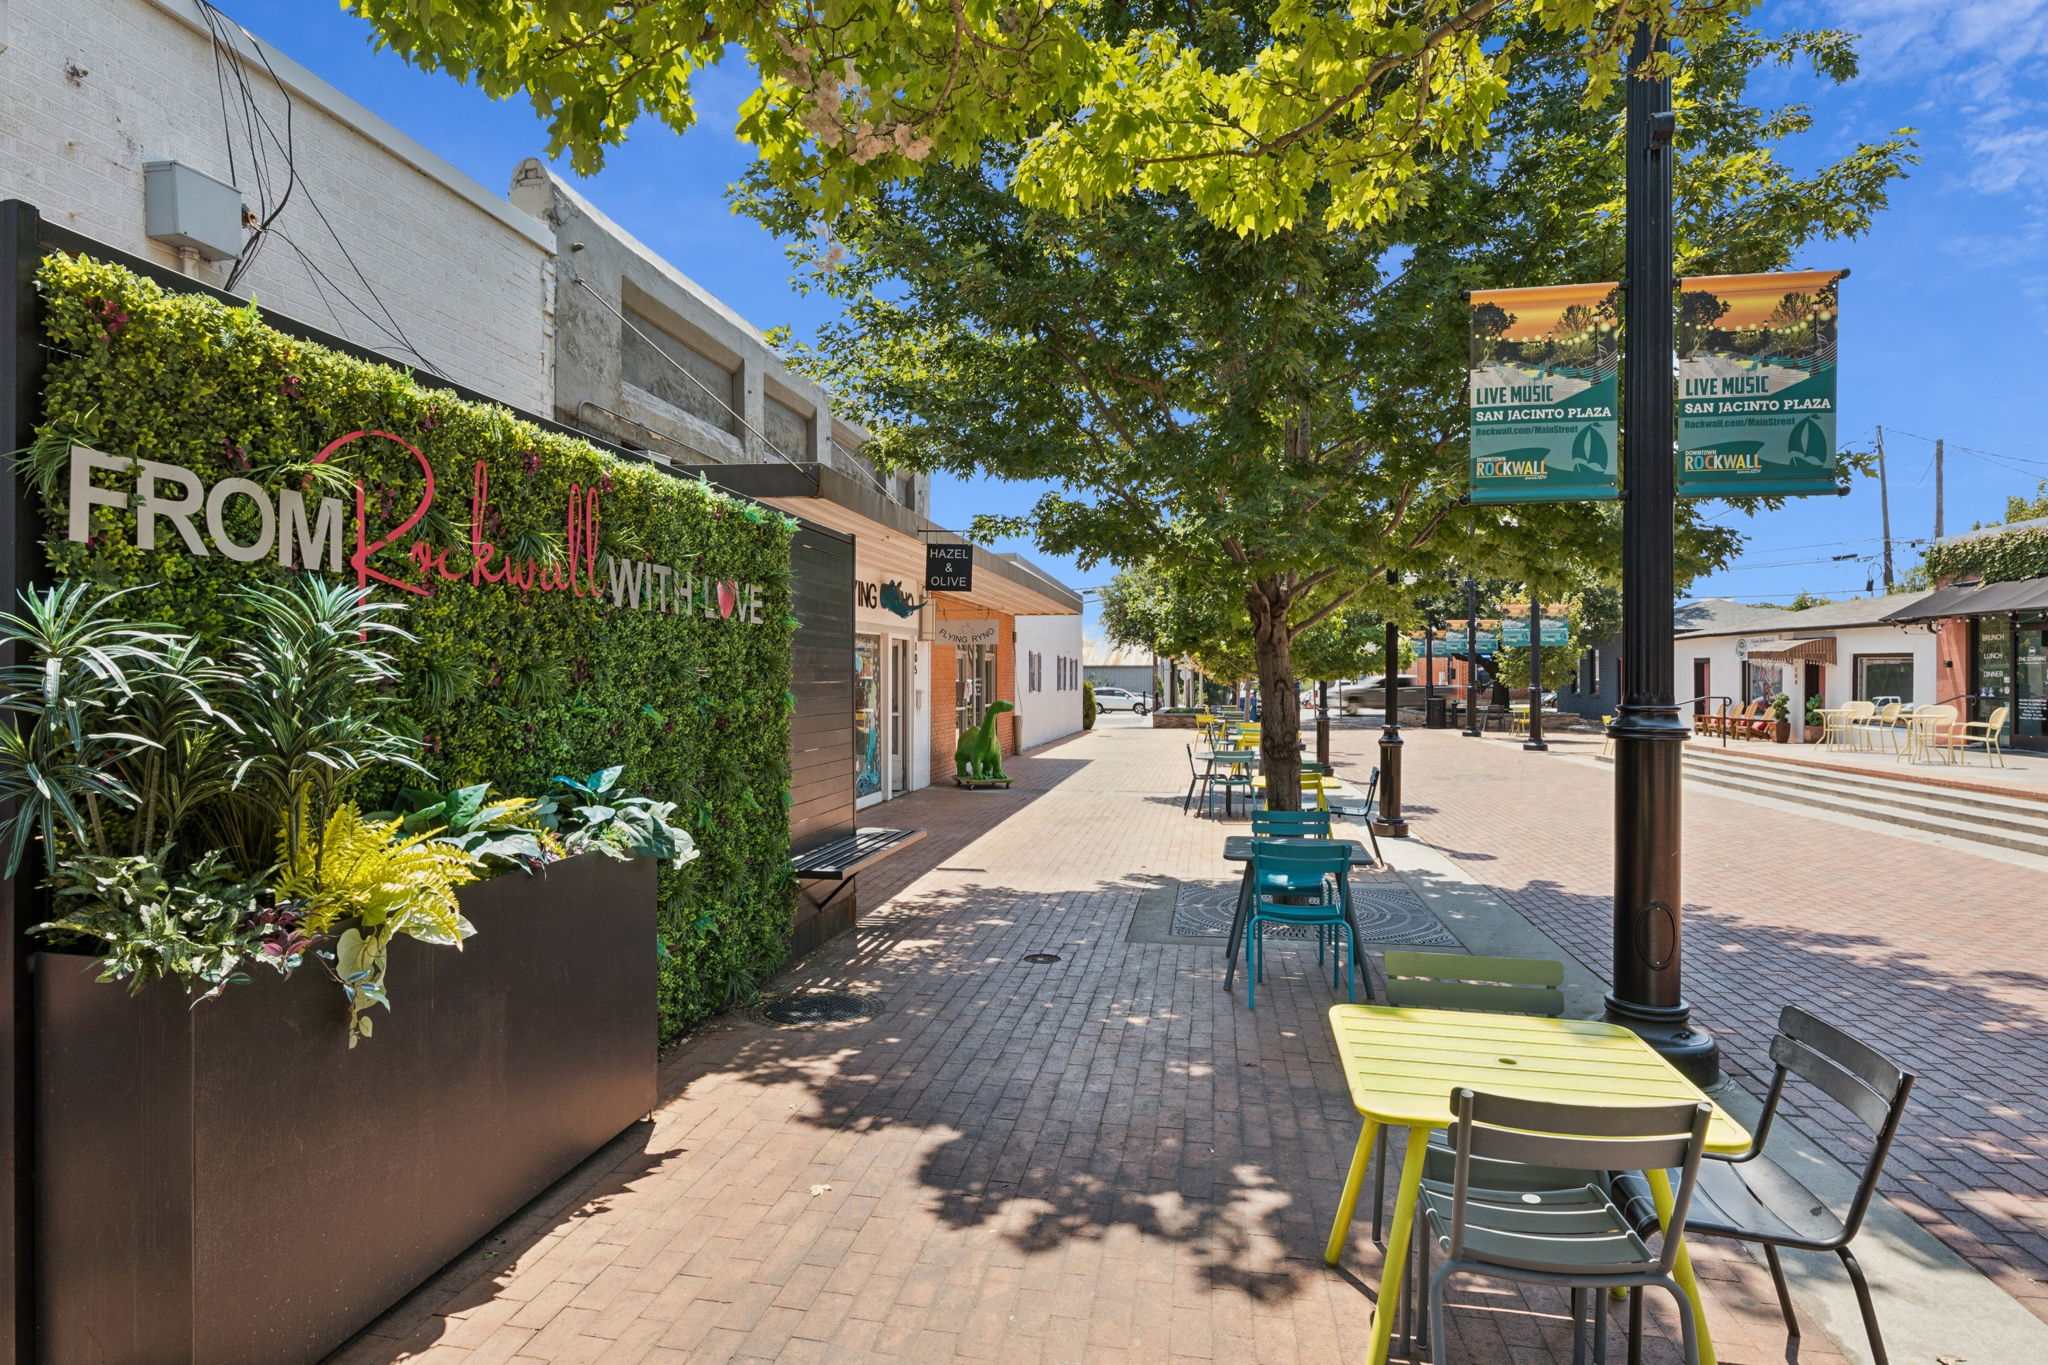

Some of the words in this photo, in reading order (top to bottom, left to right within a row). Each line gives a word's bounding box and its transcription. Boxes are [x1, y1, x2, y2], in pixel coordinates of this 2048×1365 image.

[1686, 378, 1717, 396] LIVE
[1722, 376, 1769, 394] MUSIC
[1476, 387, 1507, 405] LIVE
[1510, 385, 1554, 403] MUSIC
[1476, 410, 1504, 422] SAN
[1507, 408, 1565, 421] JACINTO
[1567, 406, 1612, 418] PLAZA
[1684, 403, 1714, 414] SAN
[1718, 401, 1780, 414] JACINTO
[1783, 399, 1831, 410] PLAZA
[1476, 425, 1578, 436] Rockwall.com/MainStreet
[1684, 417, 1795, 429] Rockwall.com/MainStreet
[1476, 460, 1548, 476] ROCKWALL
[1685, 454, 1762, 470] ROCKWALL
[68, 445, 343, 573] FROM
[300, 430, 606, 642] Rockwall
[608, 555, 692, 617] WITH
[930, 549, 968, 559] HAZEL
[945, 562, 953, 572] &
[931, 576, 966, 587] OLIVE
[939, 628, 968, 643] FLYING
[971, 627, 995, 642] RYNO
